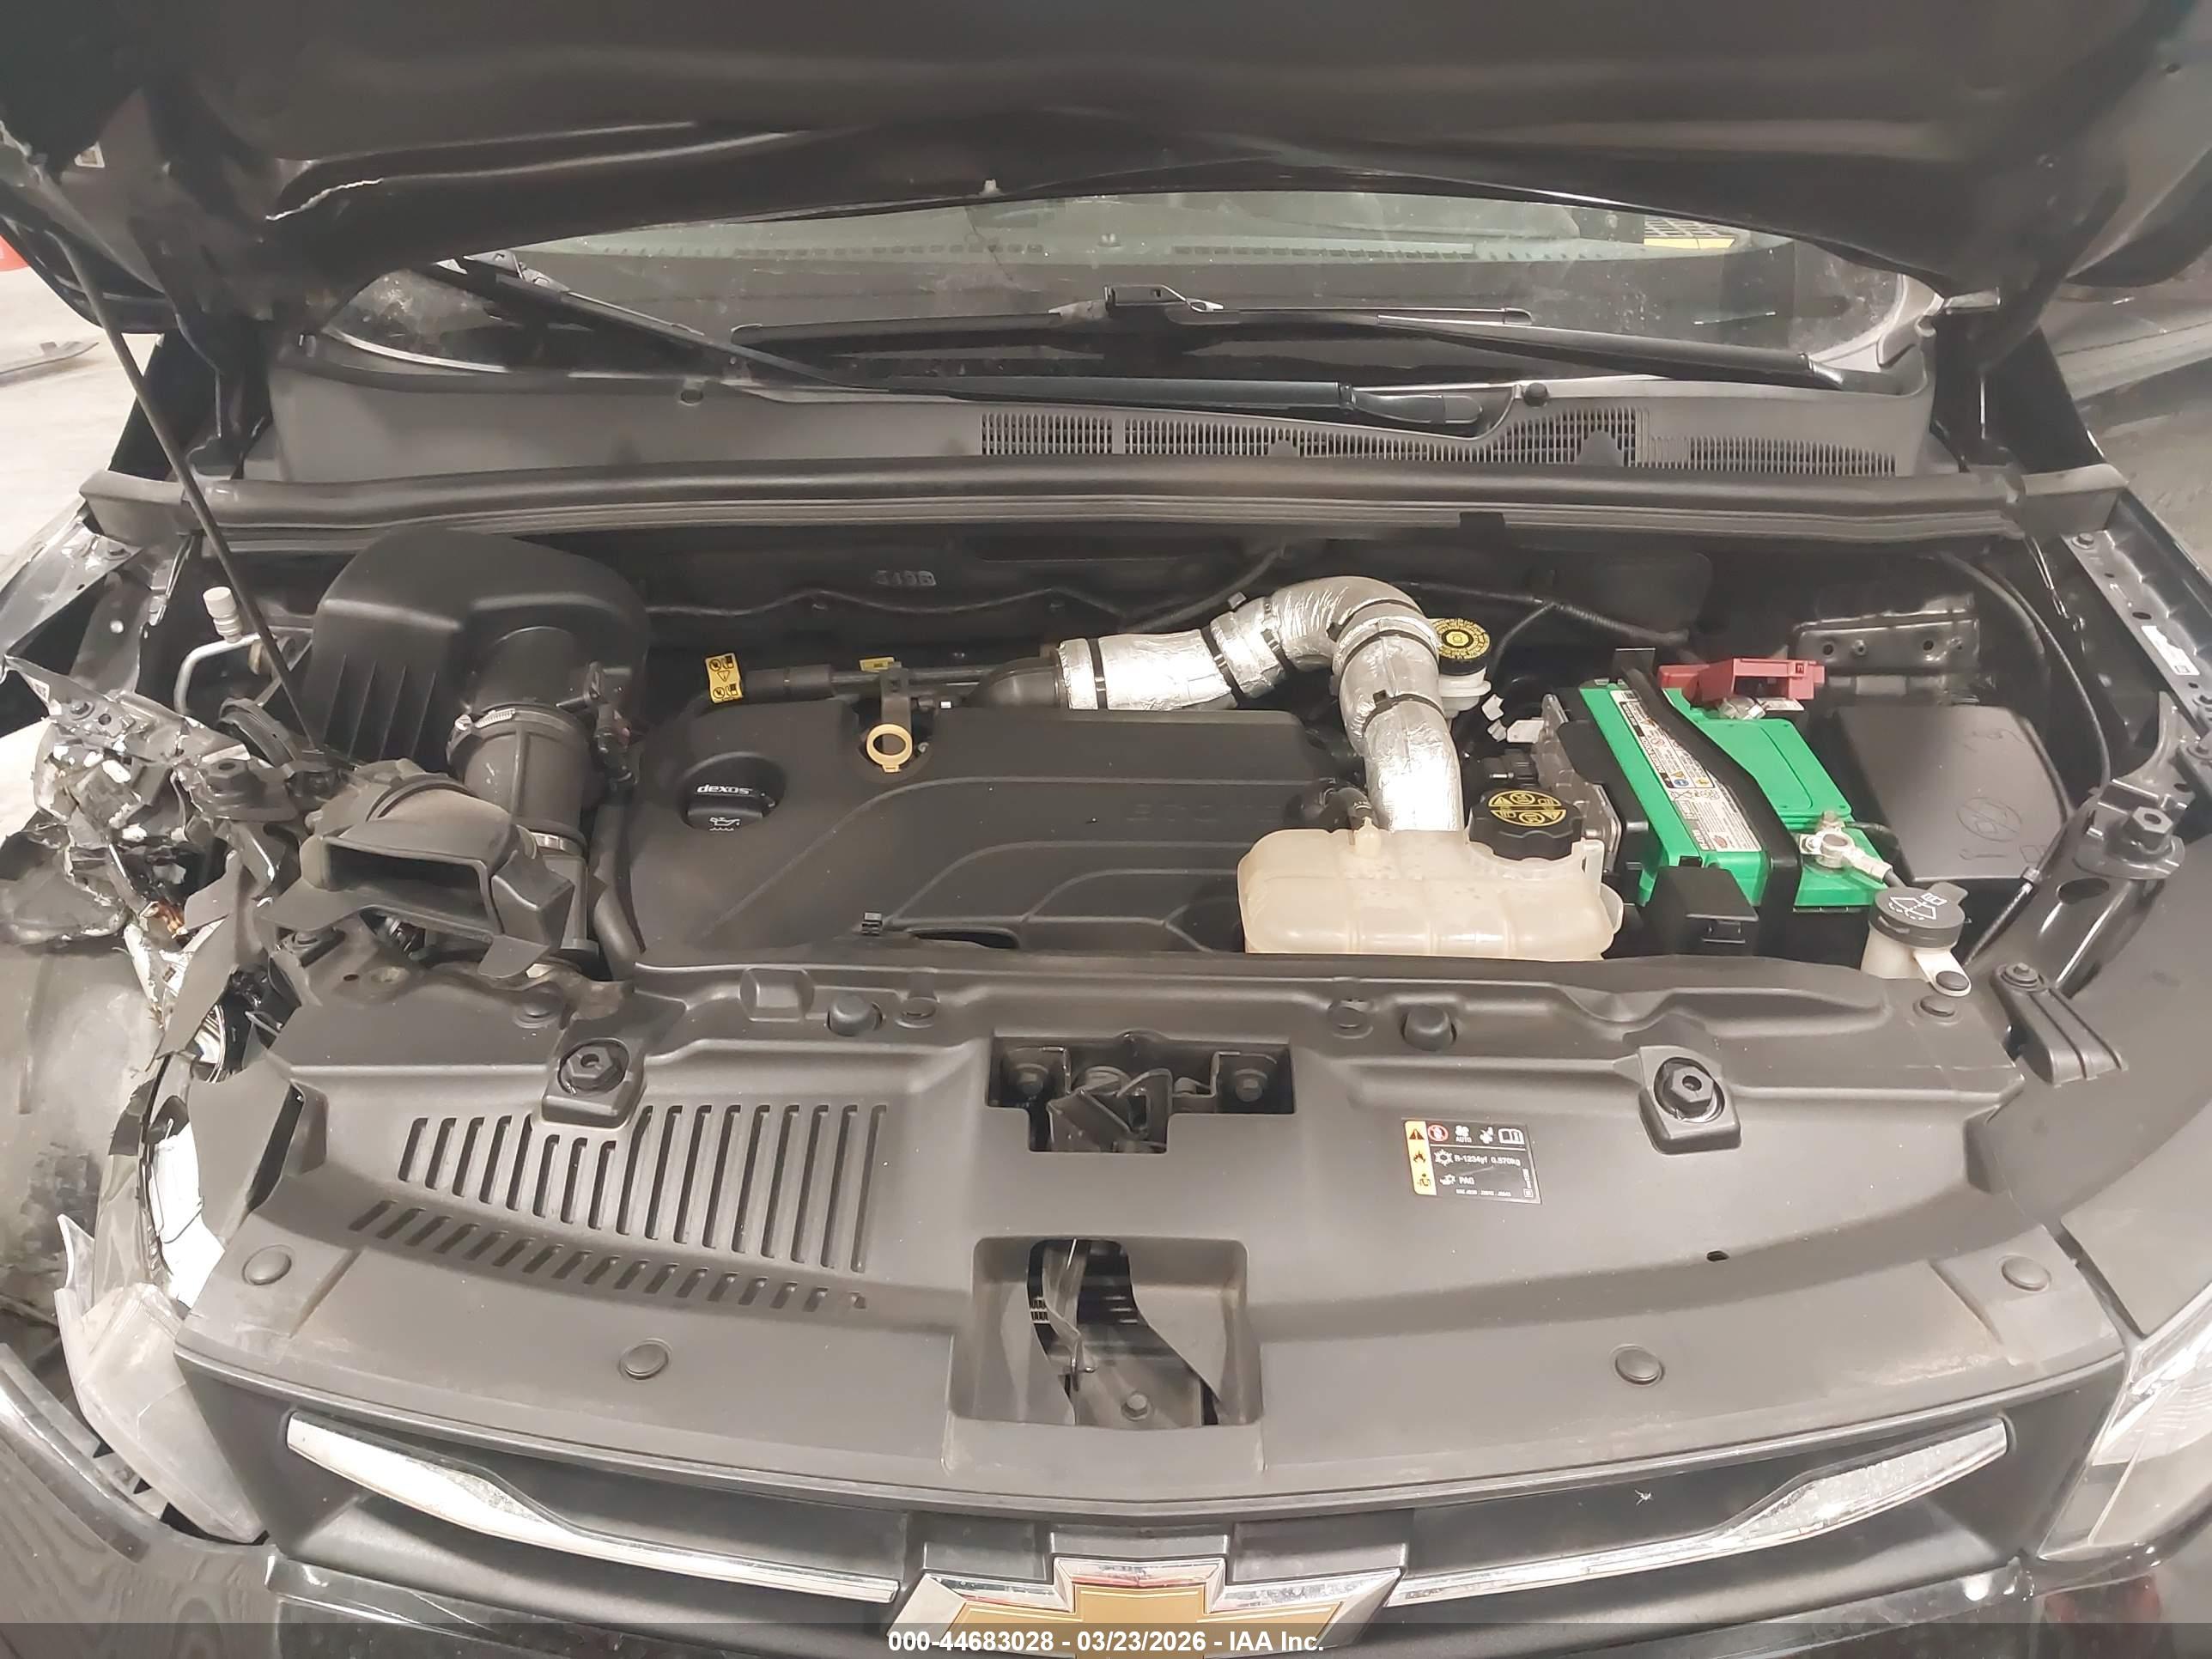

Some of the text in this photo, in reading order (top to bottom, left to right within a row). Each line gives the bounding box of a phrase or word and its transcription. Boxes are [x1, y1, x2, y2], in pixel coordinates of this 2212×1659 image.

[696, 784, 753, 794] dexos
[1454, 1154, 1487, 1164] R-1234yf
[1458, 1176, 1475, 1185] PAG
